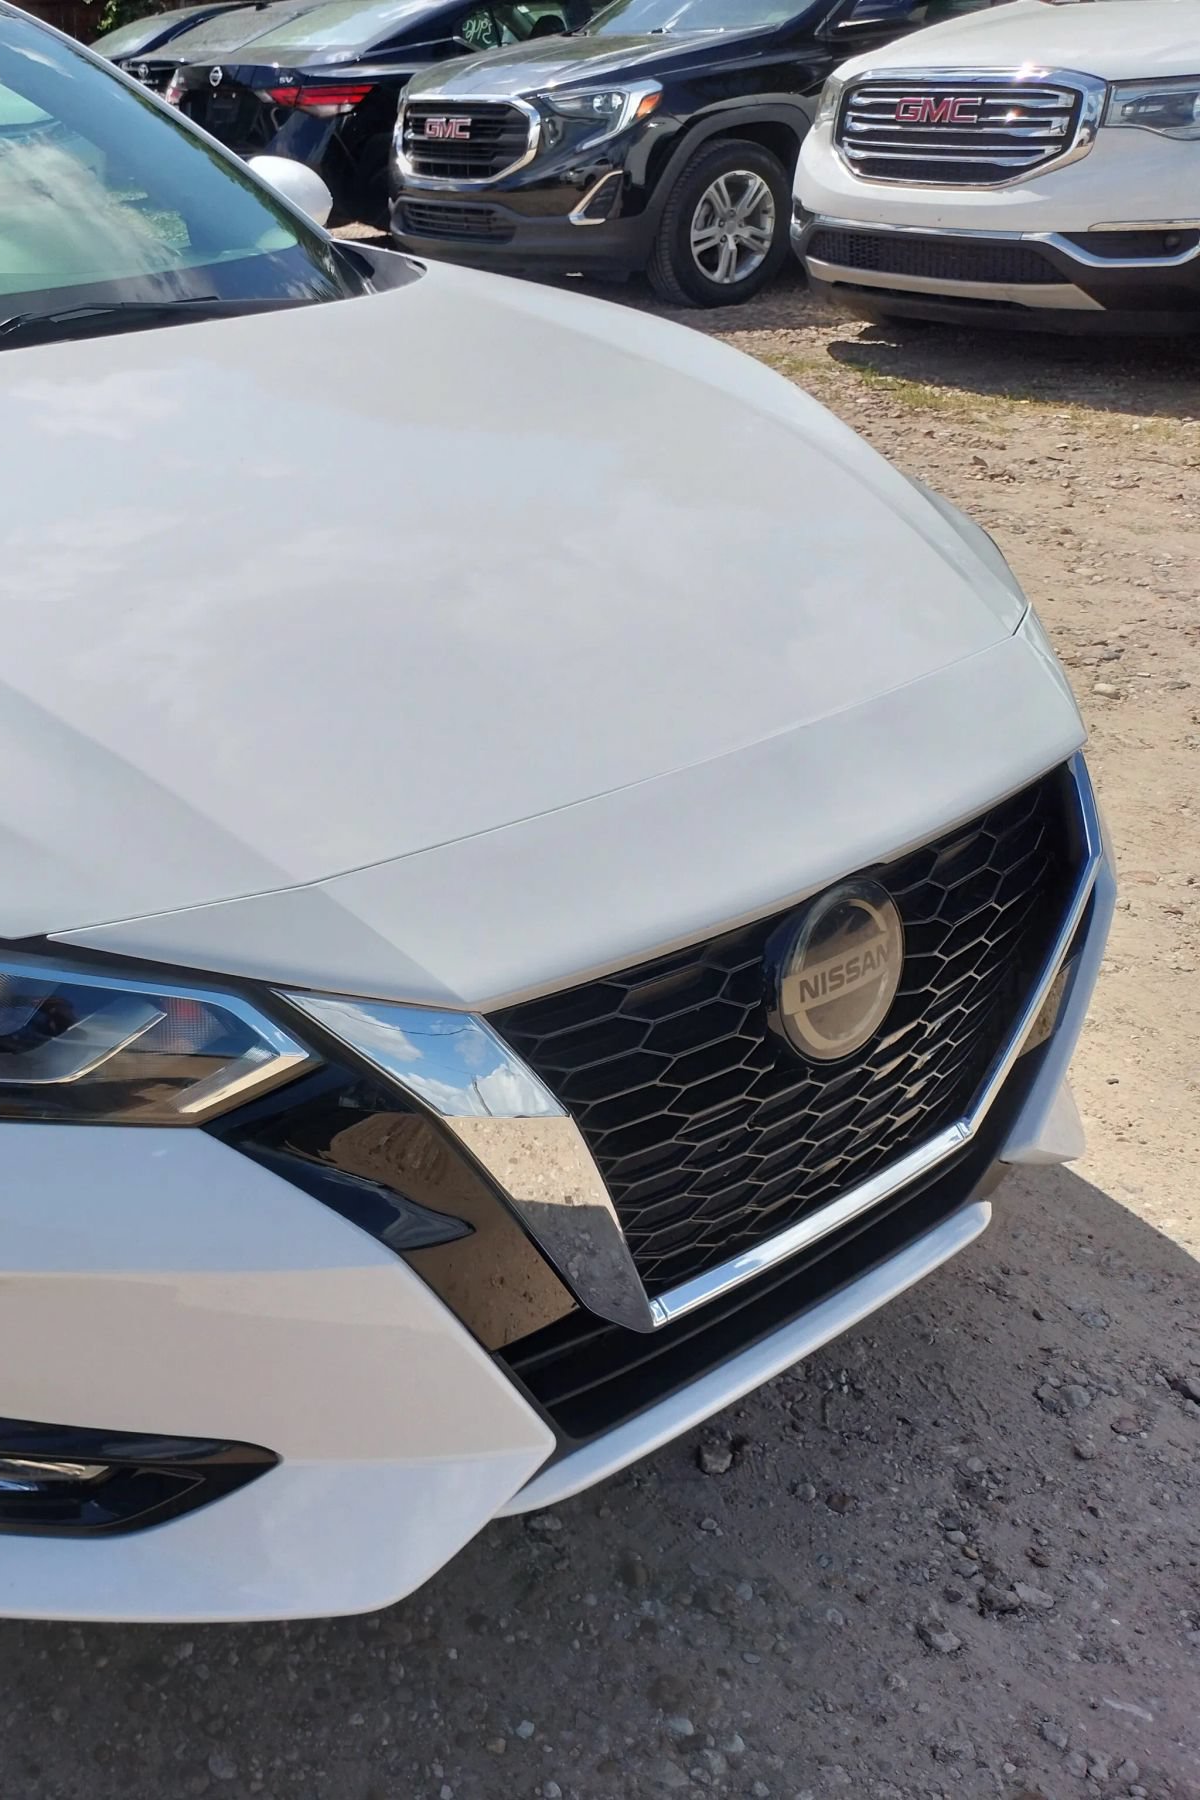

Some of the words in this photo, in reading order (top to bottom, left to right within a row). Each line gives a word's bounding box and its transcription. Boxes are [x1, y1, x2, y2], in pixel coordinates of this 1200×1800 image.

[895, 97, 982, 123] GMC
[425, 117, 472, 139] GMC
[799, 943, 890, 1003] NISSAN
